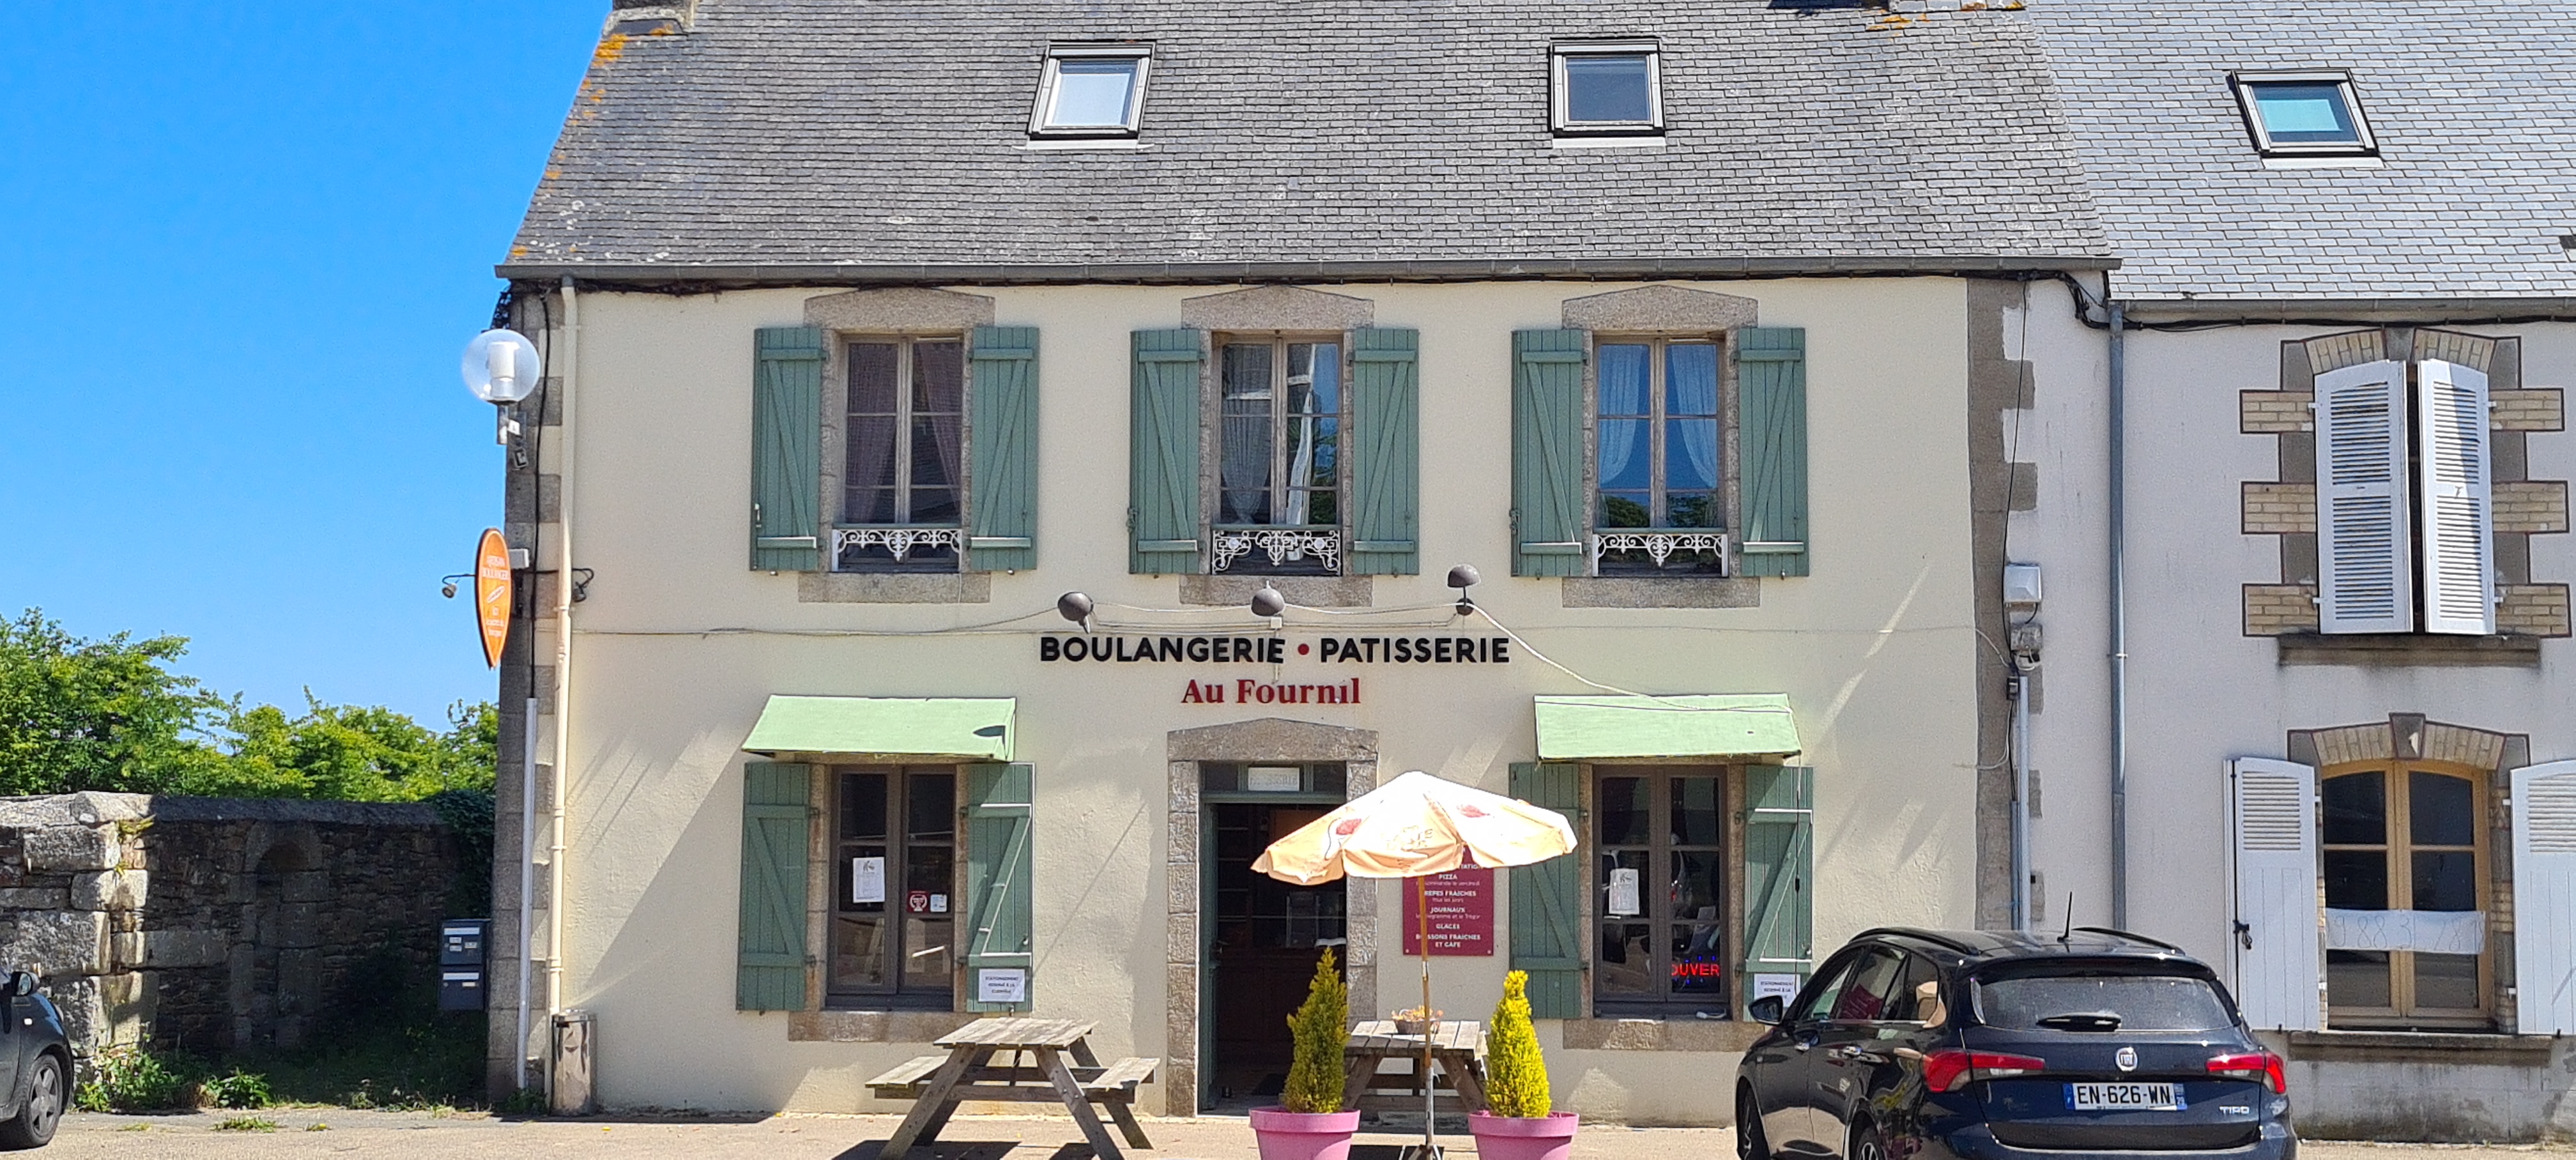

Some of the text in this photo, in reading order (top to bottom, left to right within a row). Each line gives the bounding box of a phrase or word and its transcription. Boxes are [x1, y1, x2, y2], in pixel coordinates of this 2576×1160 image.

[1040, 637, 1510, 664] BOULANGERIE PATISSERIE
[1181, 678, 1361, 703] Au Fournil
[2358, 915, 2388, 949] 88
[1671, 963, 1720, 977] OUVER
[2076, 1085, 2171, 1104] EN-626-WN
[2219, 1106, 2250, 1114] TIPO
